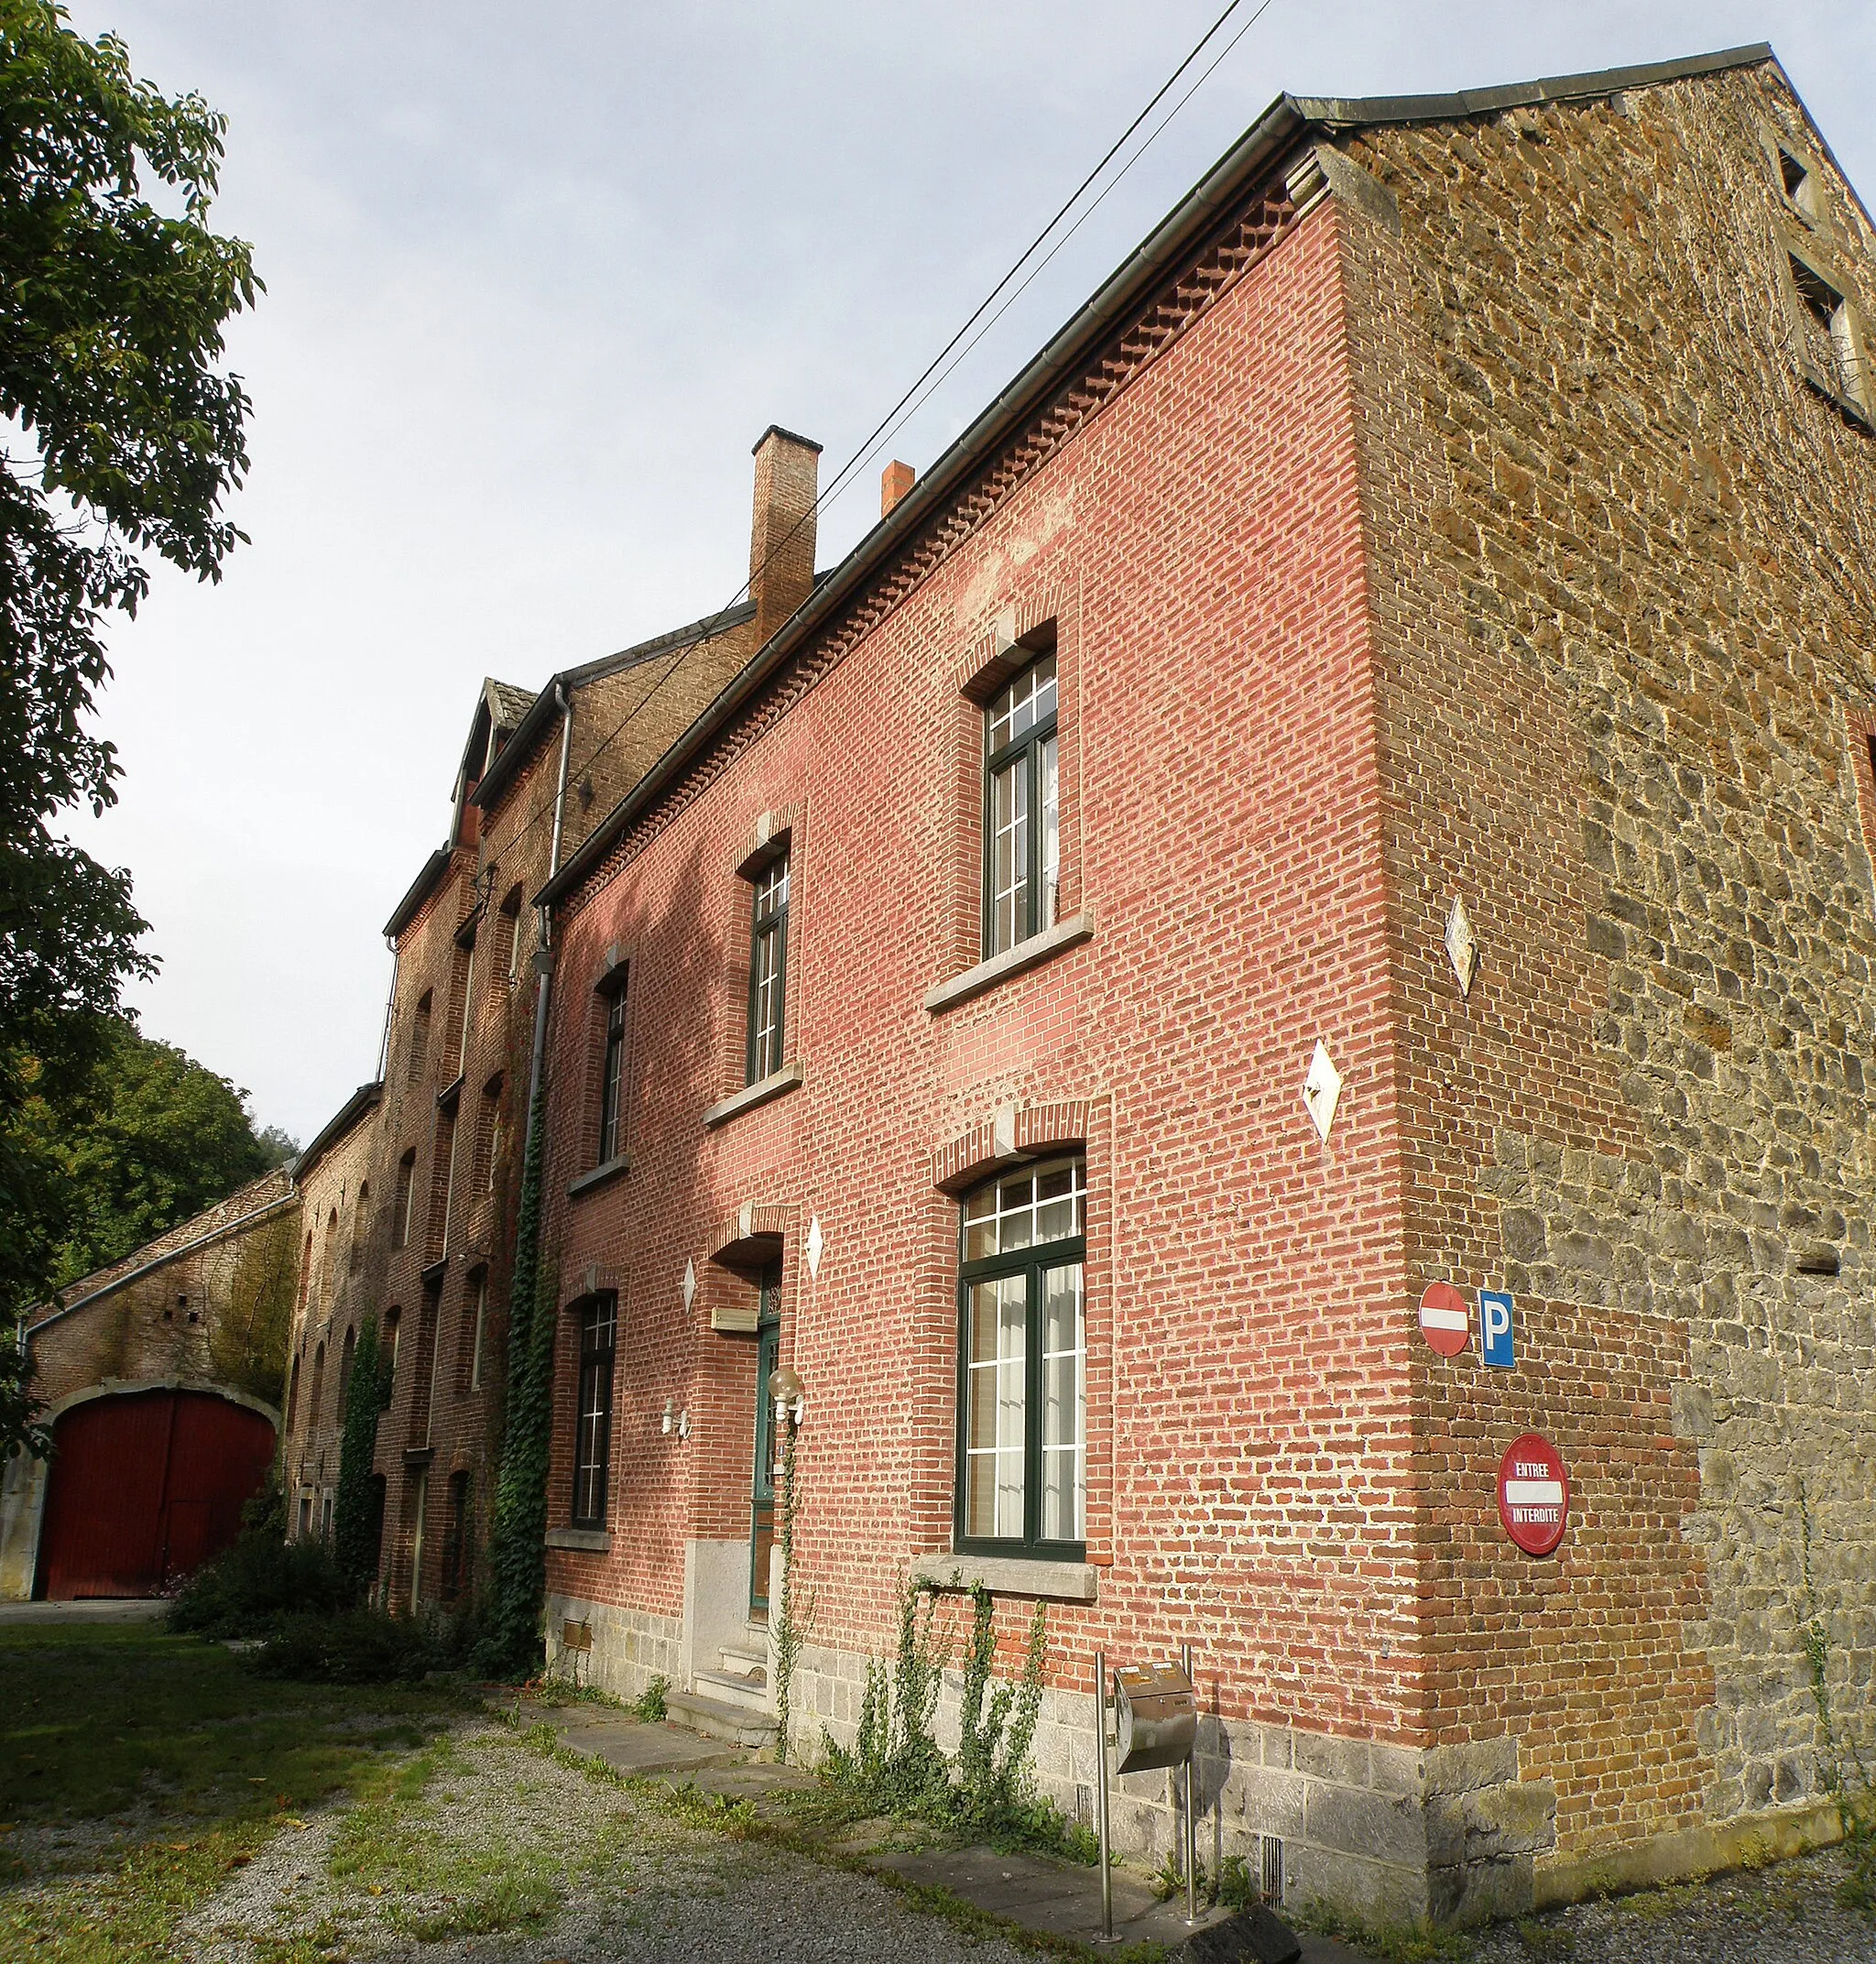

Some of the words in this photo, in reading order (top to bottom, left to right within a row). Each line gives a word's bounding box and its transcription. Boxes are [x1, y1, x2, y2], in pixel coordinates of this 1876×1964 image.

[1484, 1300, 1510, 1350] P
[1515, 1462, 1550, 1478] ENTREE
[1512, 1508, 1559, 1522] INTERDITE
